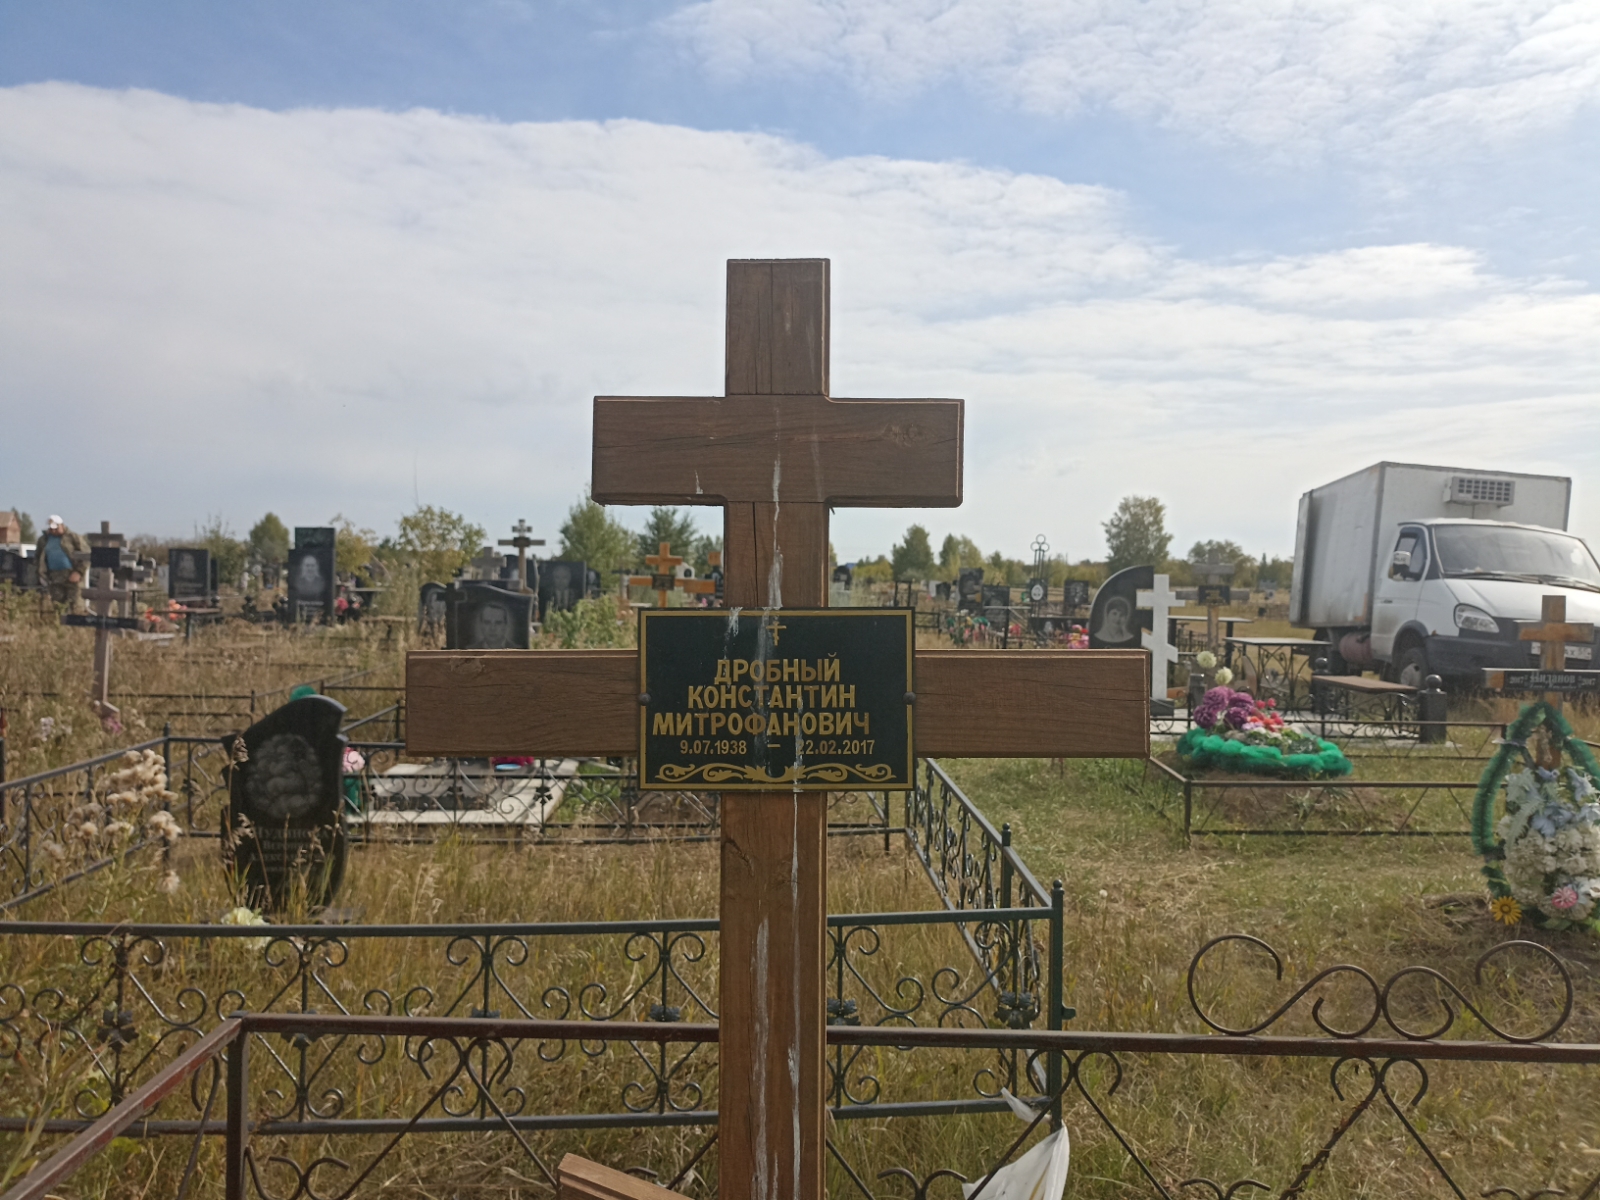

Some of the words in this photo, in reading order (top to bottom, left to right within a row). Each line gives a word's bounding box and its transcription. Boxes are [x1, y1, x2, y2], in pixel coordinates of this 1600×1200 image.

[714, 652, 840, 685] ДРОБНЫЙ
[687, 684, 856, 709] КОНСТАНТИН
[652, 712, 870, 736] МИТРОФАНОВИЧ
[680, 740, 747, 754] 9.07.1938
[796, 740, 875, 754] 22.02.2017
